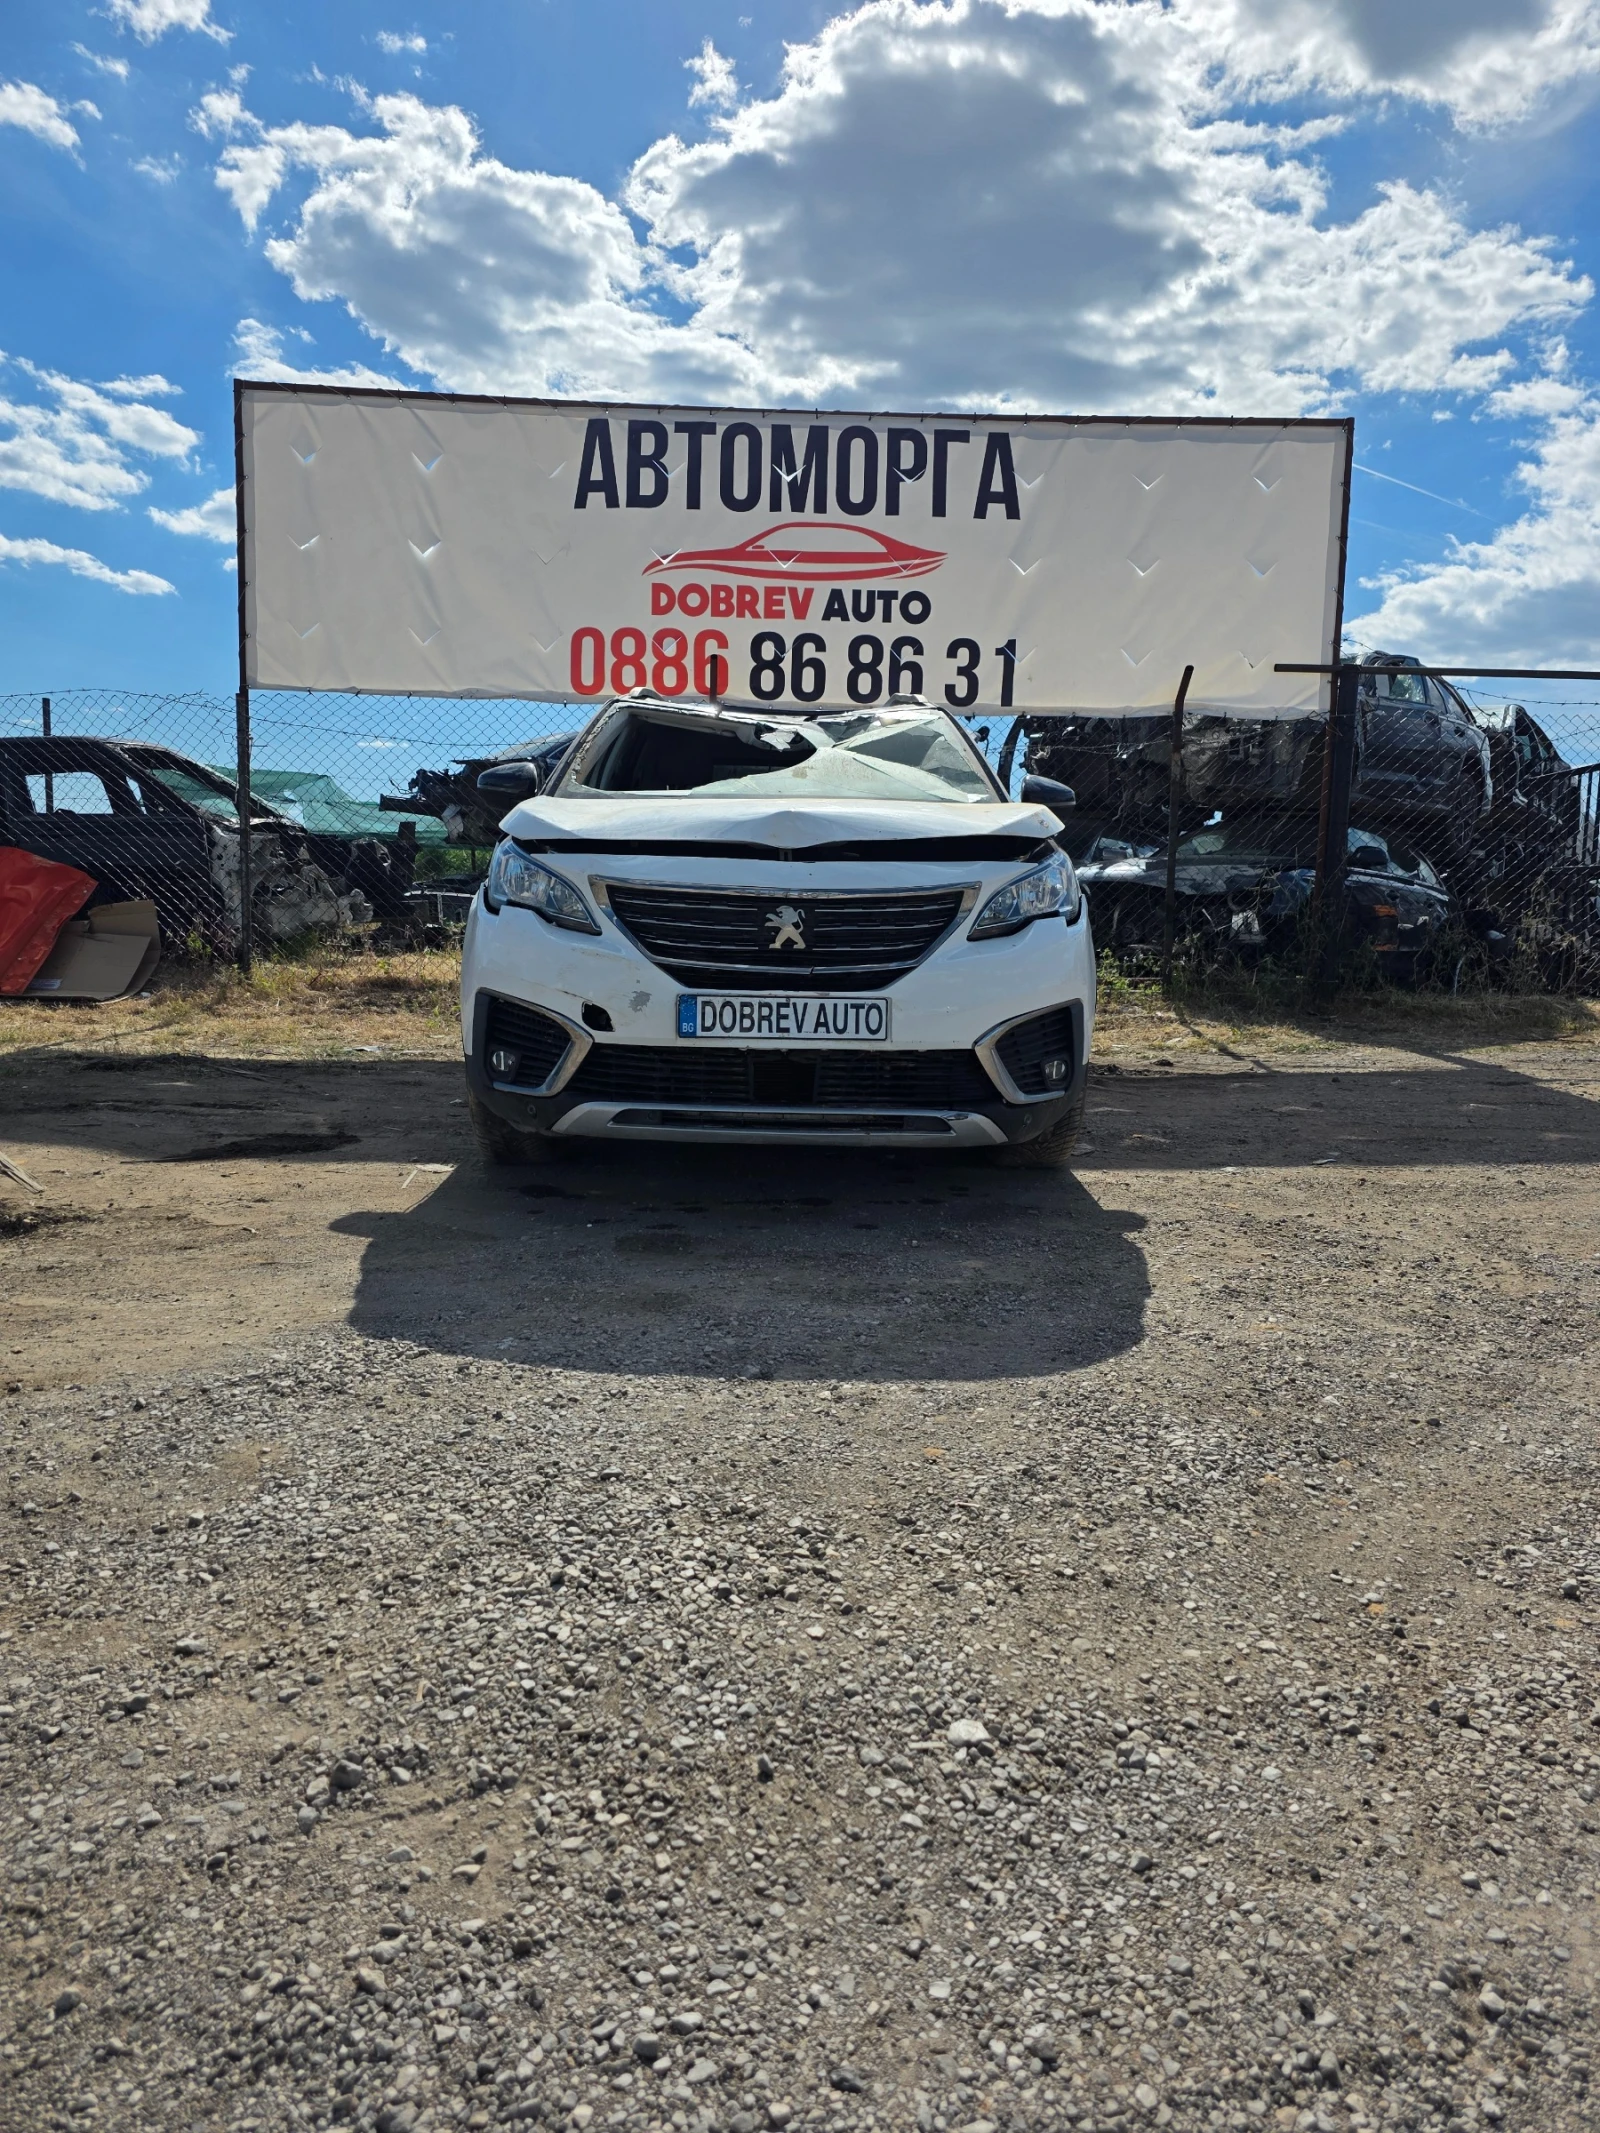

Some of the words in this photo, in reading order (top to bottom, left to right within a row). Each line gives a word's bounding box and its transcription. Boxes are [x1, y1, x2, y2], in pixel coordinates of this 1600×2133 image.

[574, 418, 1021, 520] АВТОМОРГА
[651, 582, 814, 620] DOBREV
[821, 588, 931, 624] AUTO
[570, 627, 729, 696] 0886
[749, 631, 826, 702] 86
[847, 634, 924, 704] 86
[945, 638, 1017, 707] 31
[682, 1022, 694, 1033] BG
[701, 1000, 808, 1034] DOBREV
[813, 1003, 883, 1035] AUTO
